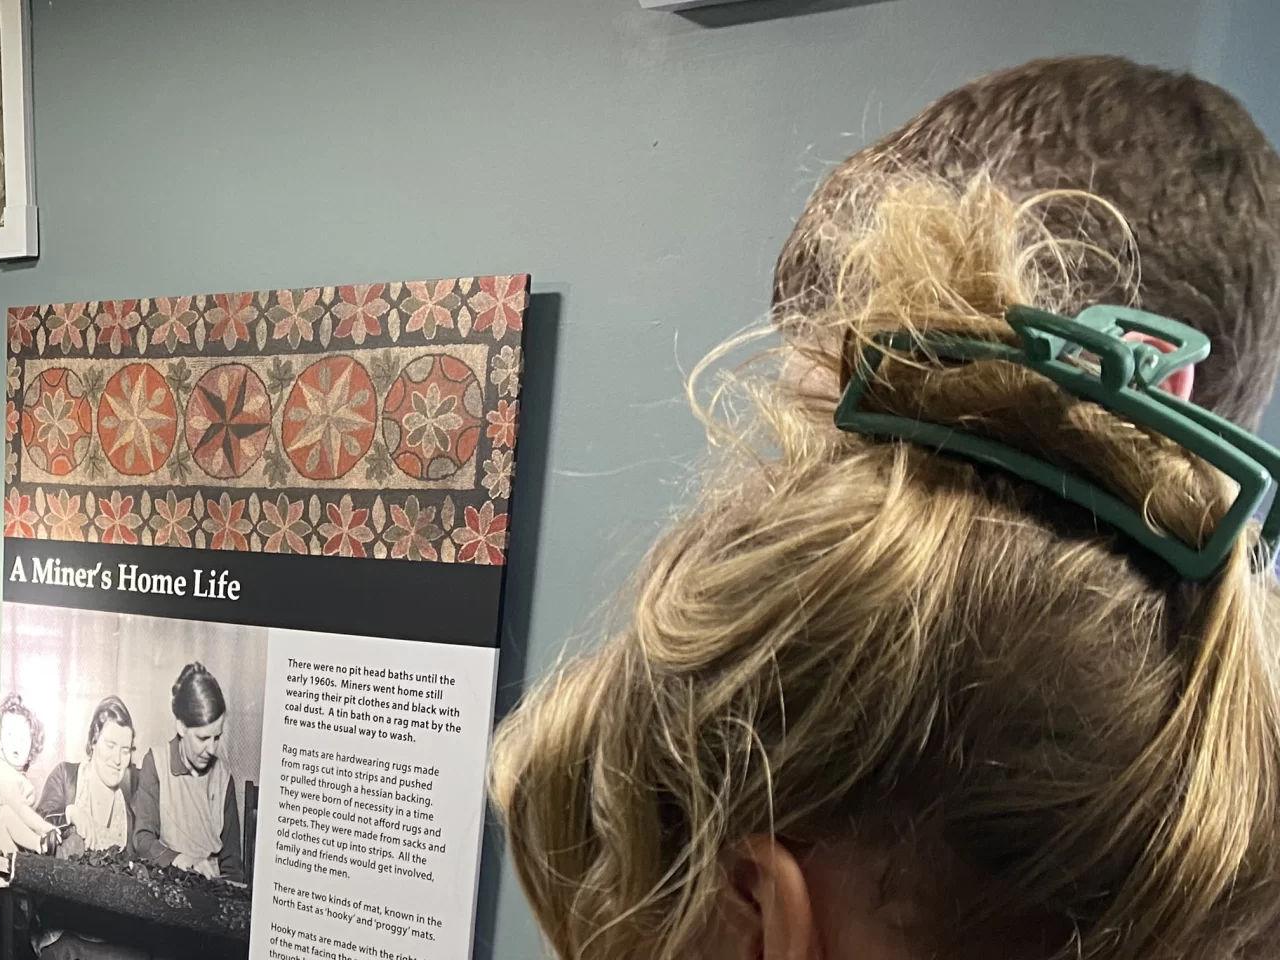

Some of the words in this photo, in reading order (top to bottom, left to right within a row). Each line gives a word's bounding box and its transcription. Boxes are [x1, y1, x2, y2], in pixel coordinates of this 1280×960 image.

[9, 556, 27, 583] A
[31, 557, 112, 590] Miner's
[116, 563, 187, 596] Home
[192, 568, 241, 601] Life
[287, 674, 308, 686] early
[310, 676, 337, 687] 1960s.
[341, 679, 371, 691] Miners
[373, 685, 395, 694] went
[397, 685, 423, 698] home
[426, 690, 443, 699] still
[288, 658, 311, 670] There
[313, 663, 334, 672] were
[336, 666, 347, 674] no
[349, 666, 361, 676] pit
[363, 666, 385, 678] head
[388, 669, 413, 681] baths
[416, 674, 437, 683] until
[440, 675, 455, 686] the
[285, 703, 302, 712] coal
[304, 704, 324, 715] dust.
[328, 707, 334, 716] A
[337, 708, 348, 718] tin
[351, 710, 370, 721] bath
[373, 715, 384, 723] on
[394, 718, 409, 729] rag
[411, 720, 429, 729] mat
[431, 720, 443, 733] by
[445, 722, 461, 733] the
[286, 689, 319, 702] wearing
[322, 692, 342, 702] their
[344, 695, 356, 705] pit
[358, 696, 390, 709] clothes
[392, 702, 409, 711] and
[412, 702, 436, 714] black
[439, 707, 460, 717] with
[284, 715, 297, 726] fire
[300, 720, 315, 728] was
[318, 720, 331, 731] the
[333, 725, 356, 734] usual
[359, 728, 376, 739] way
[379, 730, 388, 738] to
[390, 732, 415, 742] wash.
[281, 758, 300, 769] from
[302, 764, 319, 774] rags
[321, 767, 334, 775] cut
[336, 767, 353, 778] into
[355, 771, 378, 783] strips
[380, 776, 397, 785] and
[399, 779, 433, 790] pushed
[283, 744, 297, 757] Rag
[299, 749, 319, 758] mats
[321, 752, 334, 760] are
[336, 752, 390, 771] hardwearing
[392, 763, 411, 774] rugs
[414, 766, 439, 776] made
[280, 786, 299, 799] They
[301, 792, 320, 801] were
[322, 793, 341, 805] born
[344, 798, 353, 807] of
[354, 801, 394, 816] necessity
[396, 806, 404, 816] in
[414, 810, 434, 821] time
[290, 775, 316, 786] pulled
[318, 779, 352, 794] through
[361, 785, 393, 799] hessian
[395, 791, 433, 808] backing.
[278, 816, 308, 827] carpets.
[310, 820, 330, 834] They
[332, 826, 352, 836] were
[354, 830, 378, 841] made
[380, 832, 400, 845] from
[403, 839, 426, 850] sacks
[428, 844, 446, 853] and
[279, 801, 300, 812] when
[302, 806, 330, 818] people
[332, 812, 355, 822] could
[358, 816, 372, 825] not
[374, 818, 400, 830] afford
[402, 824, 421, 835] rugs
[424, 828, 441, 837] and
[276, 841, 301, 856] family
[302, 849, 317, 857] and
[319, 850, 348, 864] friends
[350, 858, 376, 869] would
[378, 864, 392, 873] get
[394, 865, 434, 882] involved,
[277, 828, 290, 838] old
[291, 831, 320, 844] clothes
[322, 838, 335, 847] cut
[337, 841, 348, 851] up
[350, 841, 367, 853] into
[368, 847, 394, 859] strips.
[398, 851, 410, 861] All
[412, 854, 427, 865] the
[275, 855, 312, 873] including
[314, 863, 327, 874] the
[329, 868, 350, 878] men.
[273, 896, 295, 908] North
[297, 901, 313, 913] East
[356, 917, 373, 926] and
[412, 929, 435, 941] mats.
[274, 882, 295, 895] There
[297, 889, 309, 898] are
[312, 892, 327, 902] two
[329, 894, 351, 907] kinds
[353, 901, 362, 909] of
[363, 904, 382, 915] mat,
[385, 906, 414, 921] known
[417, 914, 425, 924] in
[427, 916, 442, 928] the
